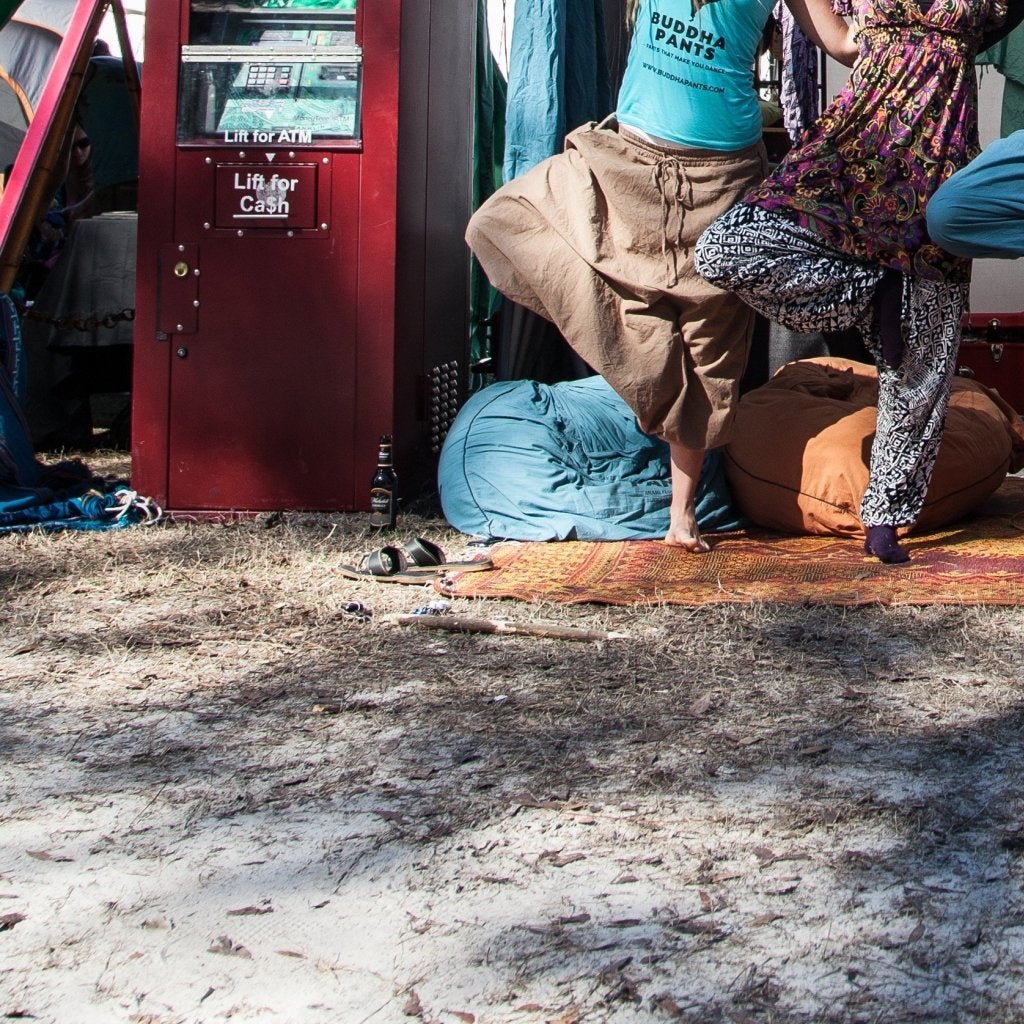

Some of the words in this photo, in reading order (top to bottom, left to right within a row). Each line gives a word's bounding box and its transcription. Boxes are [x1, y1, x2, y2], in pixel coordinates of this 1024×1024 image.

[651, 11, 726, 51] BUDDHA
[655, 27, 716, 61] PANTS
[661, 48, 674, 58] THAT
[674, 55, 691, 65] MAKE
[691, 61, 705, 69] YOU
[642, 61, 726, 94] WWW.BUDDHAPANTS.COM
[224, 129, 249, 143] Lift
[253, 129, 276, 143] for
[277, 129, 312, 143] ATM
[234, 172, 265, 190] Lift
[270, 174, 299, 192] for
[240, 195, 290, 215] Ca$h
